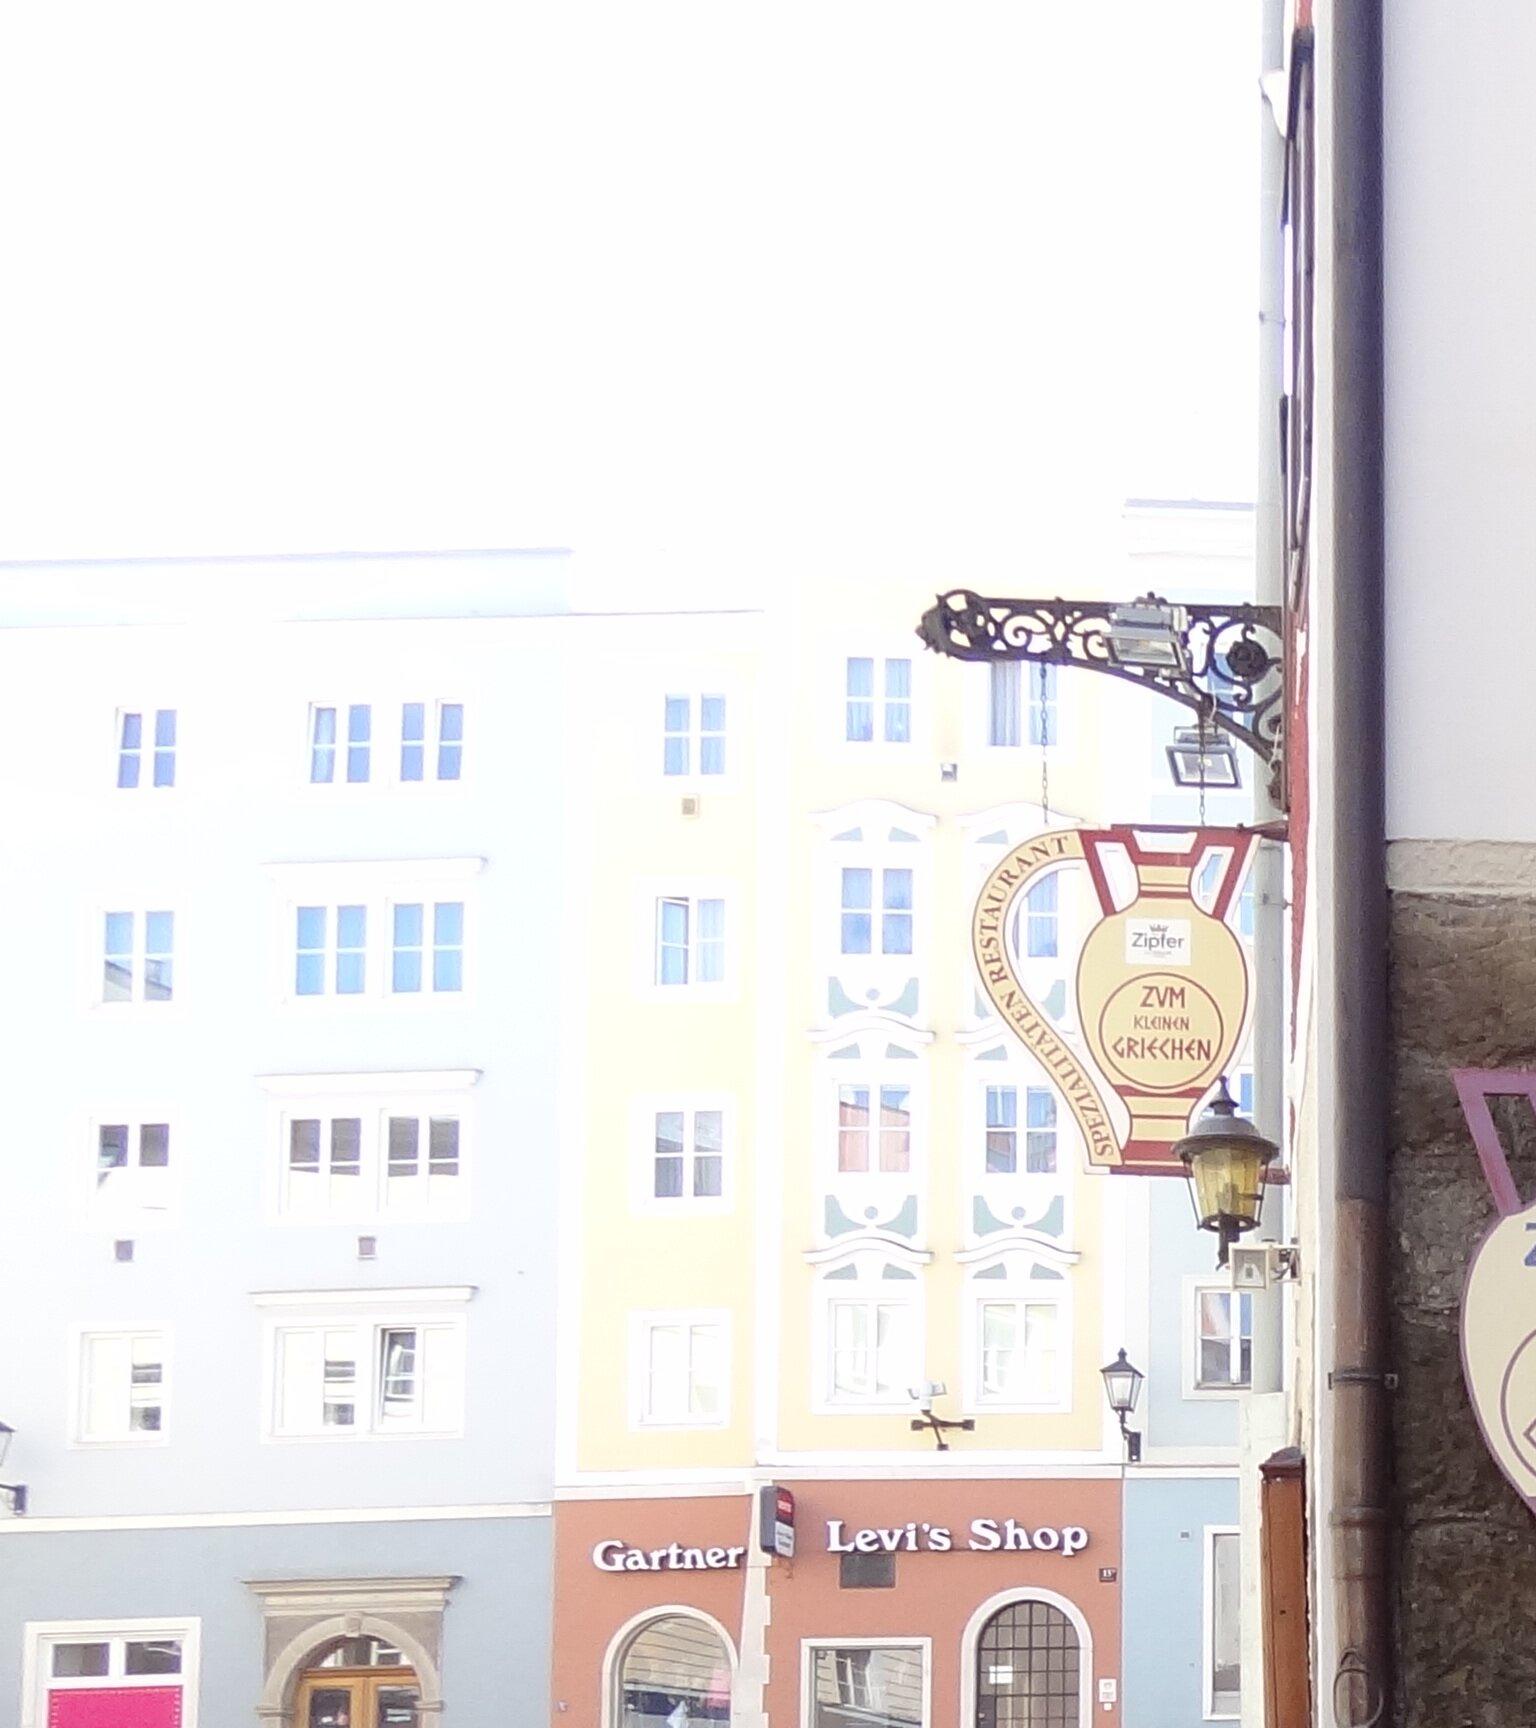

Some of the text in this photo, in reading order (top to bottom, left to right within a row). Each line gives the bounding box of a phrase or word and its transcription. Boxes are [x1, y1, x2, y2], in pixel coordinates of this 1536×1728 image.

[979, 836, 1069, 986] RESTAURANT
[1132, 931, 1185, 951] Zipfer
[1133, 1014, 1190, 1031] KLEINEN
[1111, 1036, 1211, 1062] GRIECHEN
[826, 1520, 952, 1553] Levi's
[968, 1518, 1089, 1556] Shop
[592, 1540, 744, 1572] Gartner
